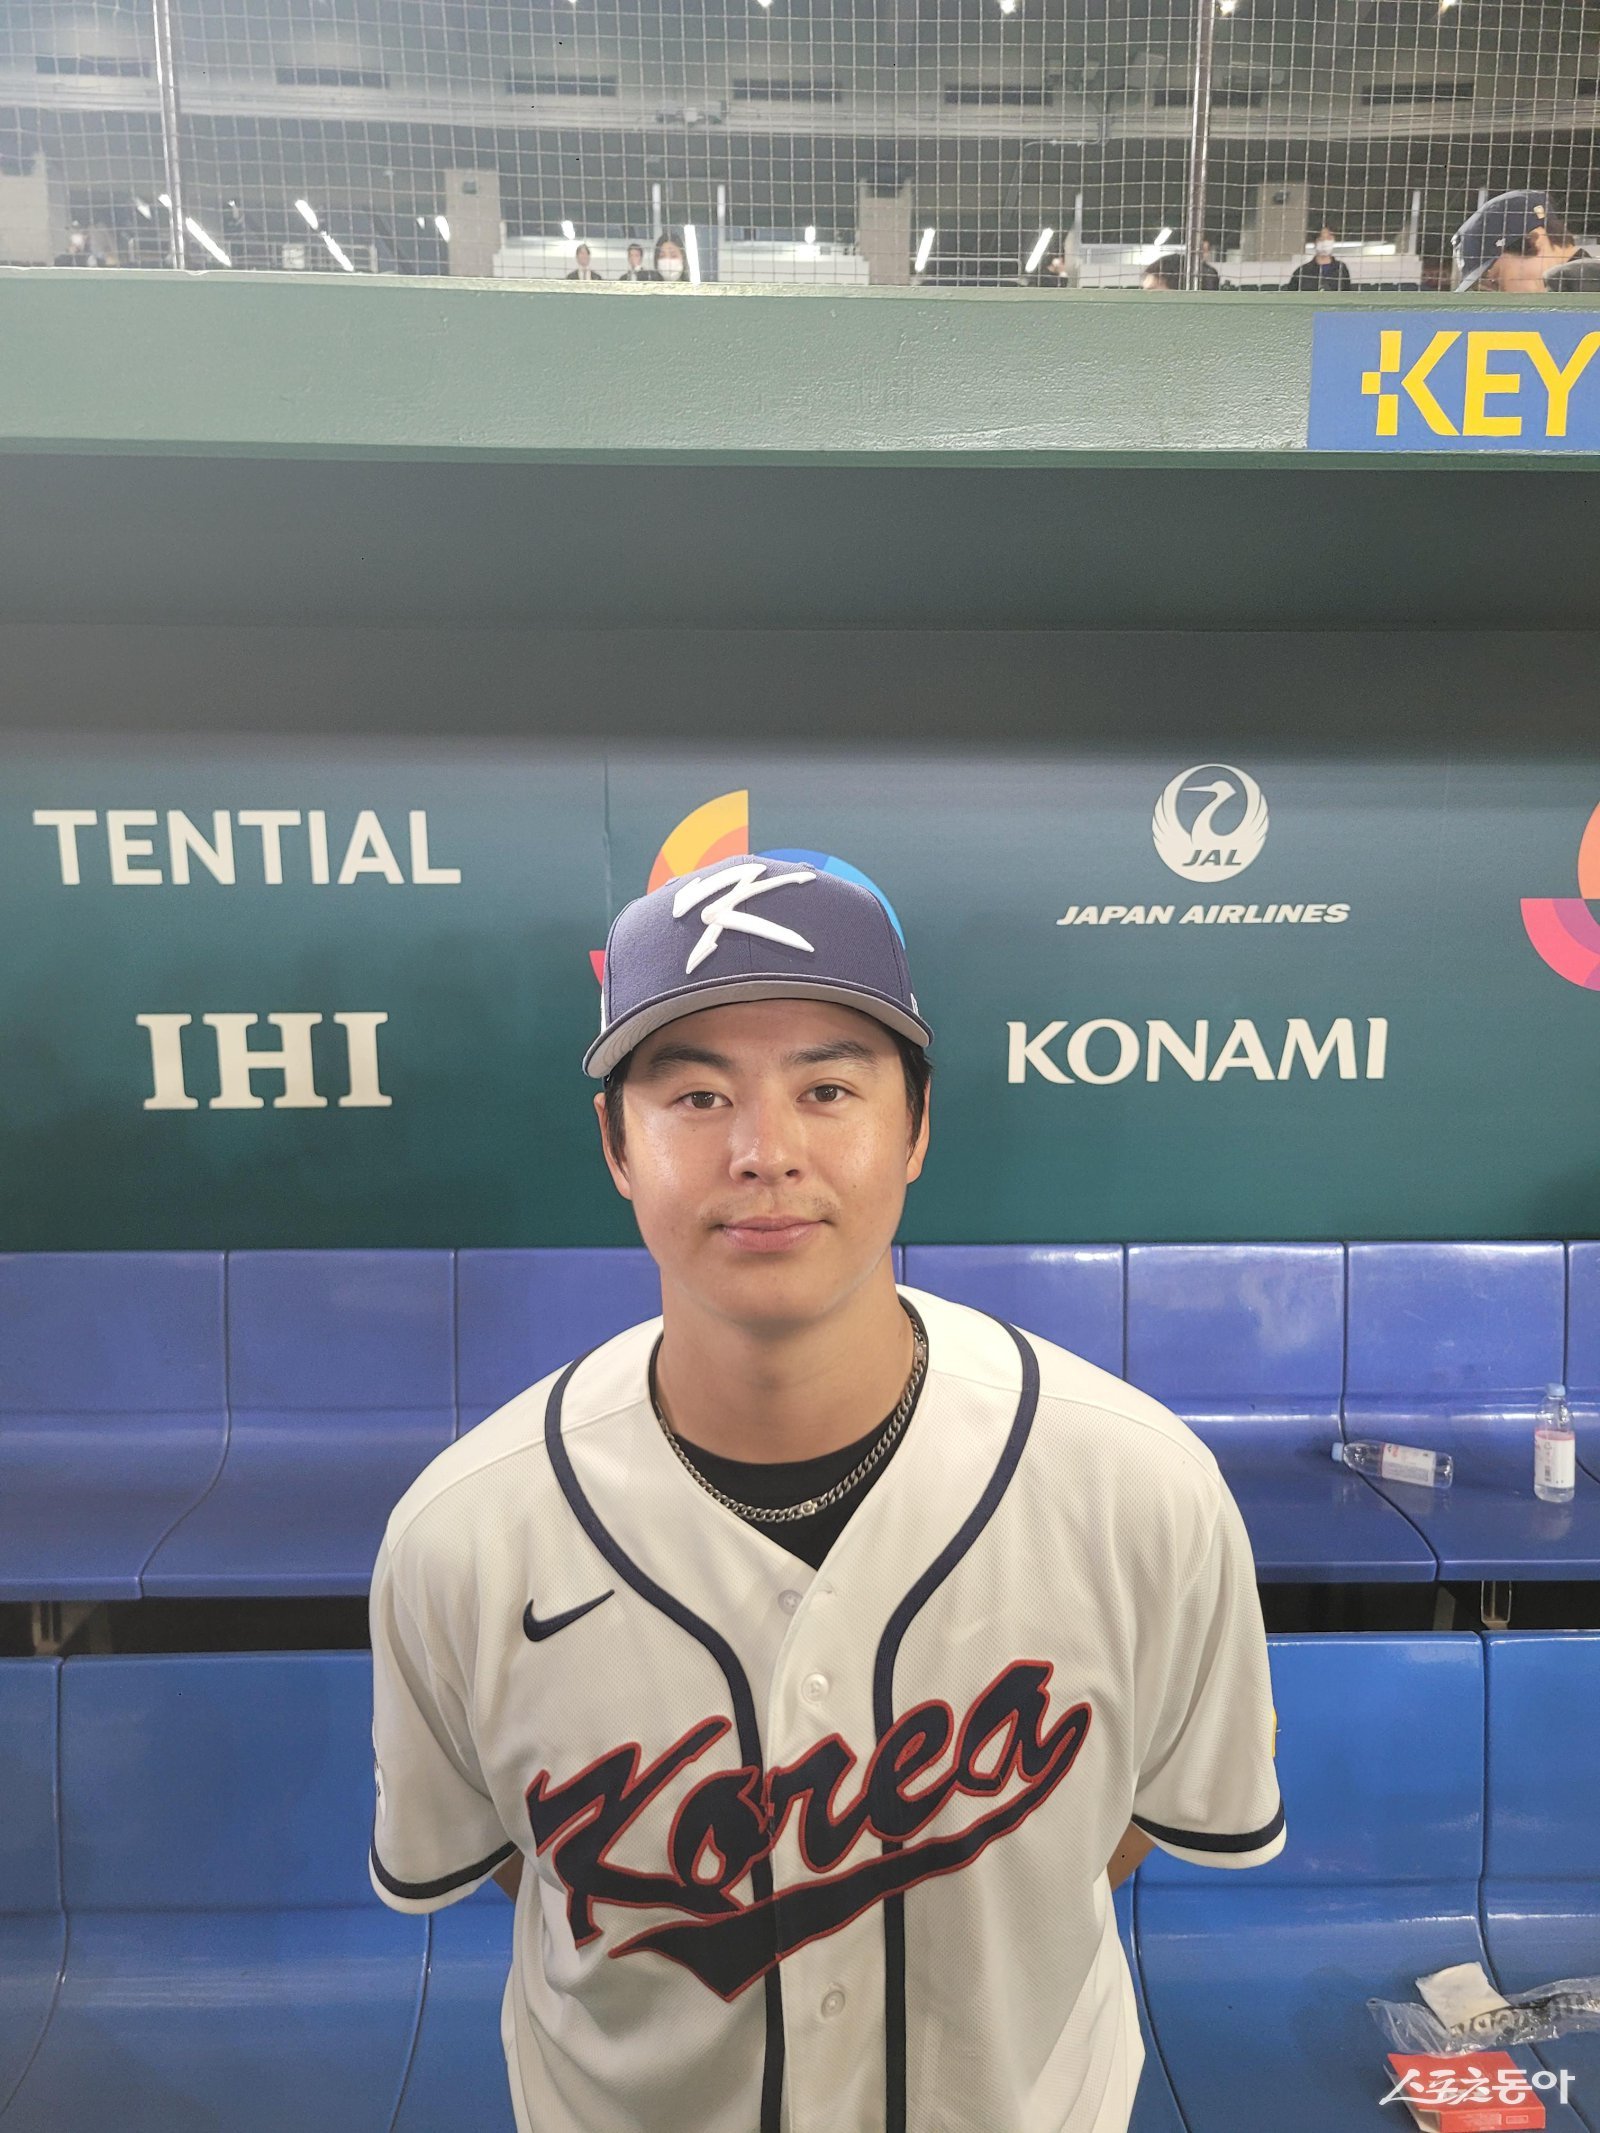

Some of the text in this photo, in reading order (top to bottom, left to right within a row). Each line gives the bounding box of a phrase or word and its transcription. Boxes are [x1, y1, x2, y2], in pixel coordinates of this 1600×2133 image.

[1361, 330, 1600, 436] KEY
[32, 810, 462, 885] TENTIAL
[1182, 849, 1242, 867] JAL
[1056, 903, 1351, 926] JAPAN AIRLINES
[135, 1012, 393, 1110] IHI
[1006, 1018, 1389, 1085] KONAMI
[525, 1659, 1093, 1952] Korea
